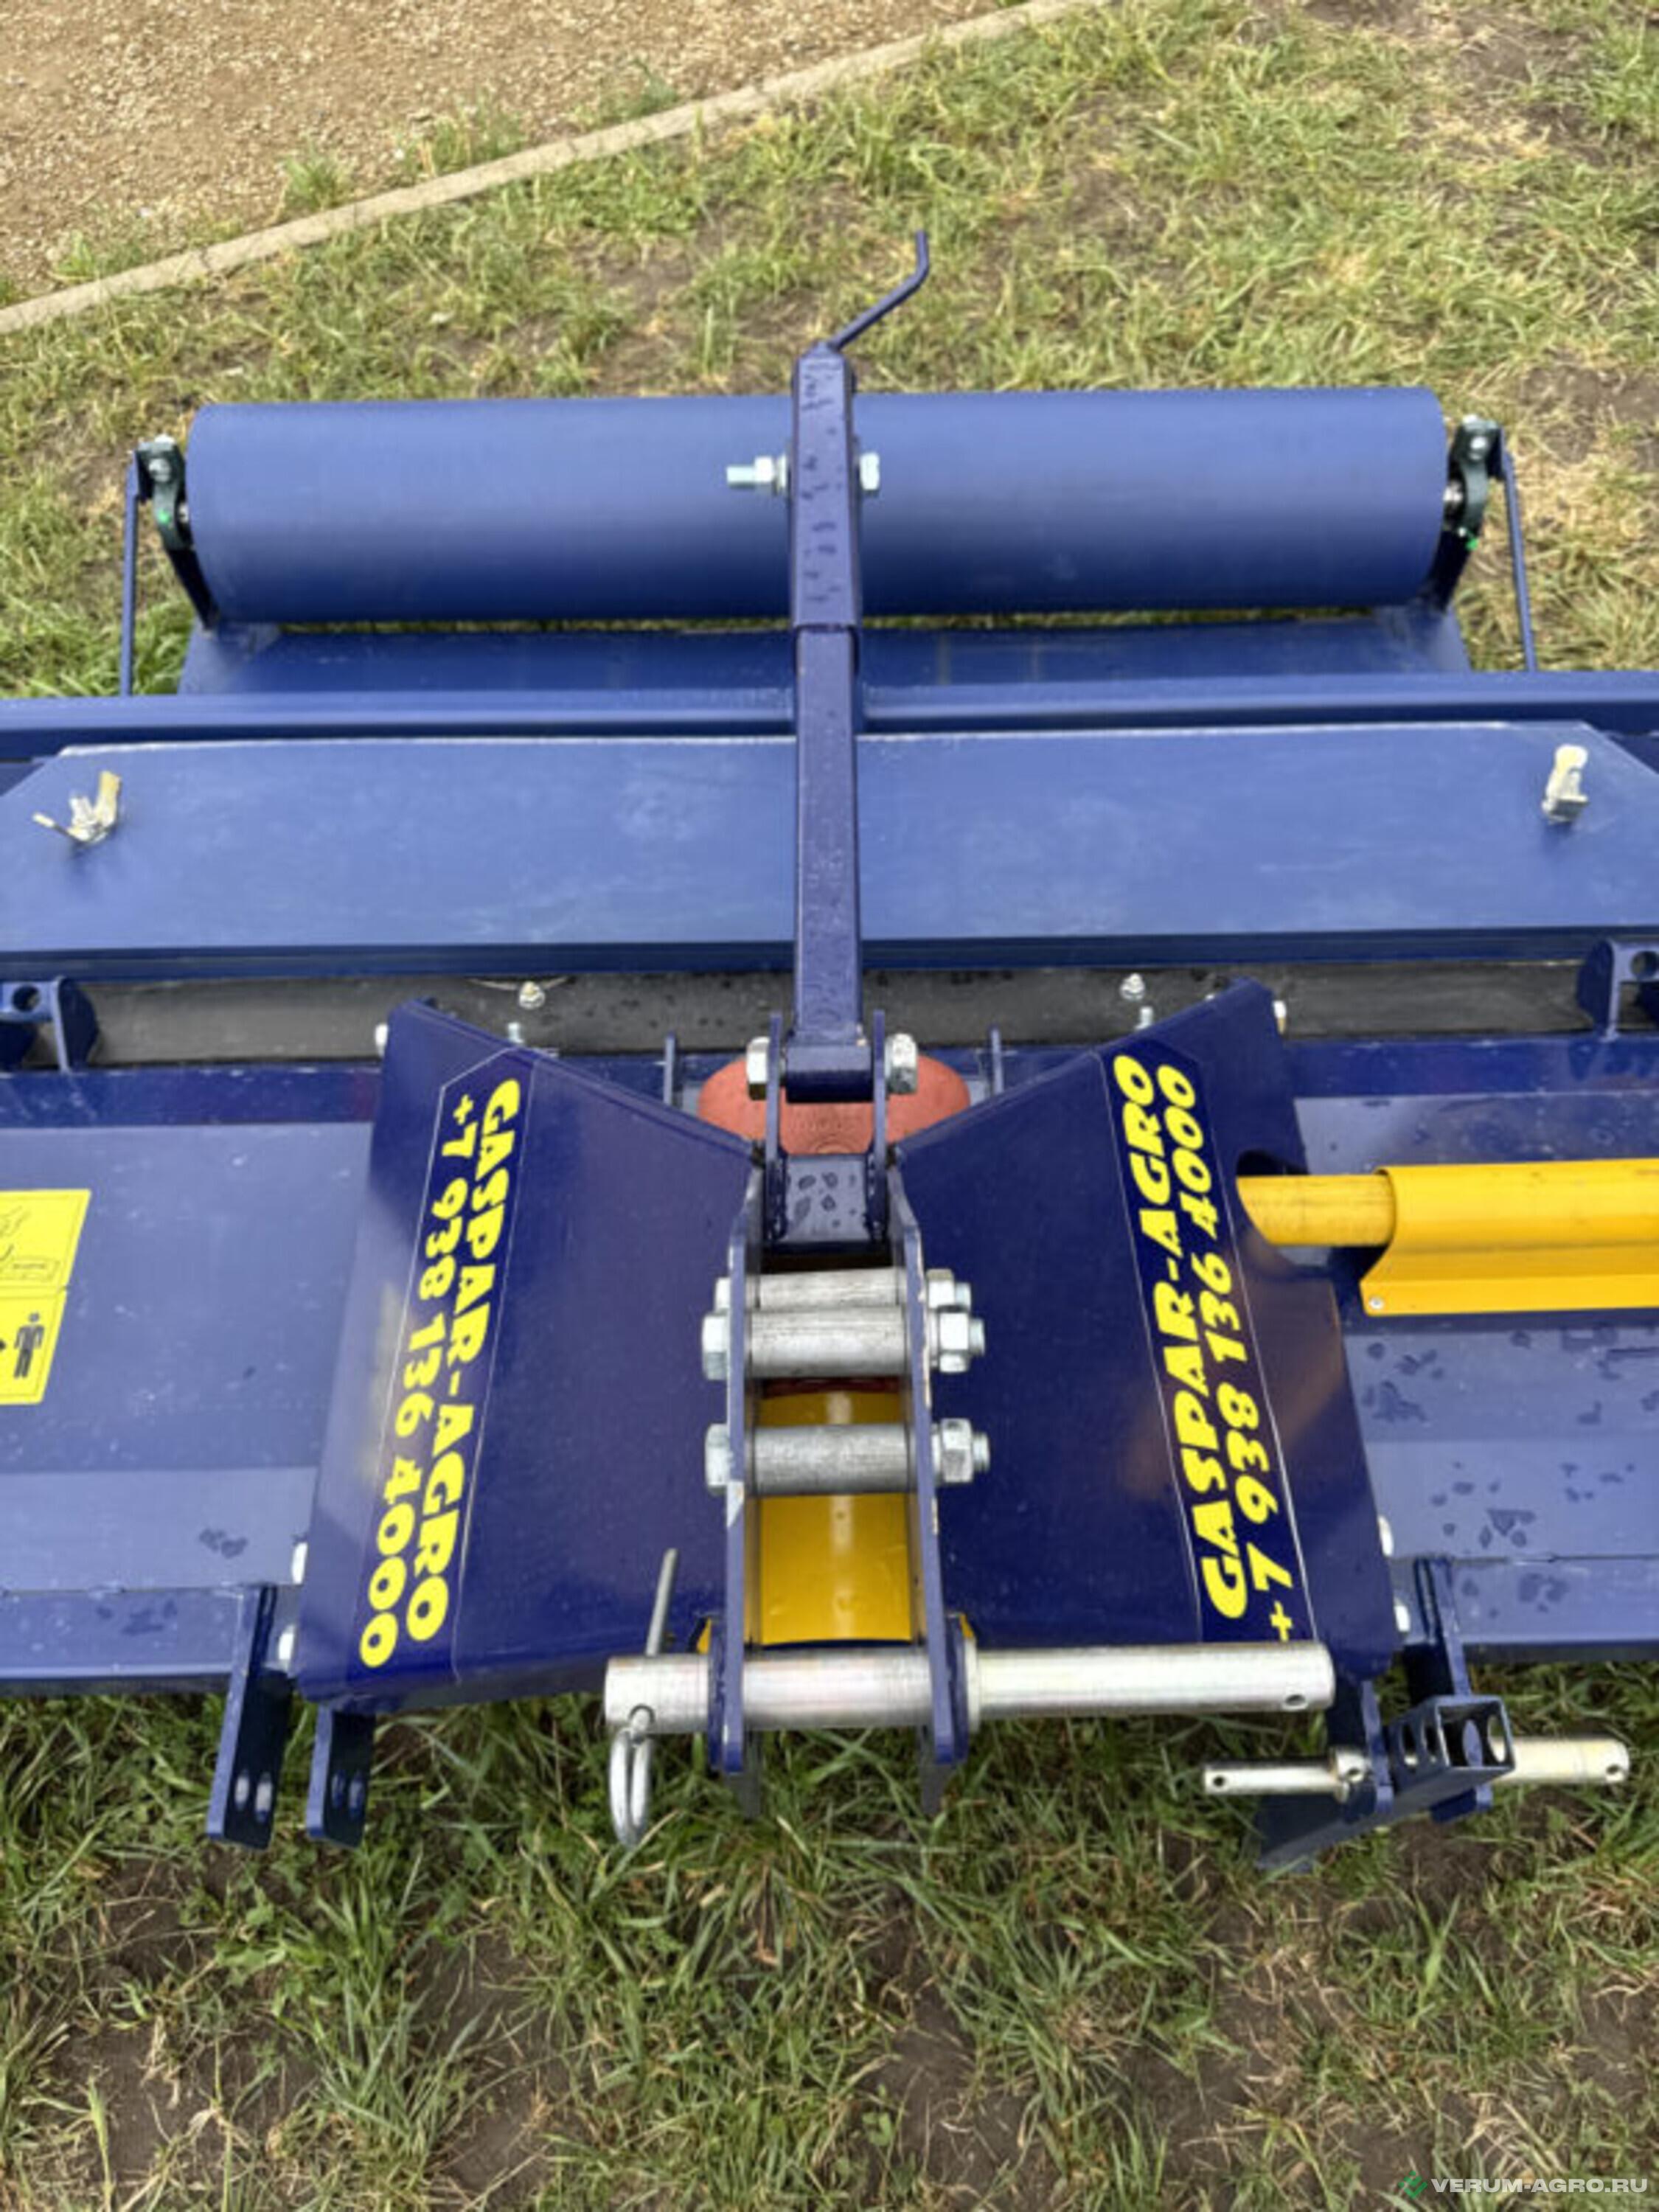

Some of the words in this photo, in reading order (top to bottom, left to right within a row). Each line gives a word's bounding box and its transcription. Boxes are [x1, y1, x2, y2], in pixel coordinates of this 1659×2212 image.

[442, 1094, 478, 1156] +7
[1157, 1064, 1219, 1240] 4000
[419, 1178, 468, 1300] 938
[406, 1079, 521, 1641] GASPAR-AGRO
[1113, 1055, 1247, 1618] GASPAR-AGRO
[1191, 1252, 1248, 1363] 136
[394, 1312, 445, 1437] 136
[1216, 1382, 1279, 1523] 938
[358, 1455, 422, 1668] 4000
[1246, 1542, 1293, 1641] +7
